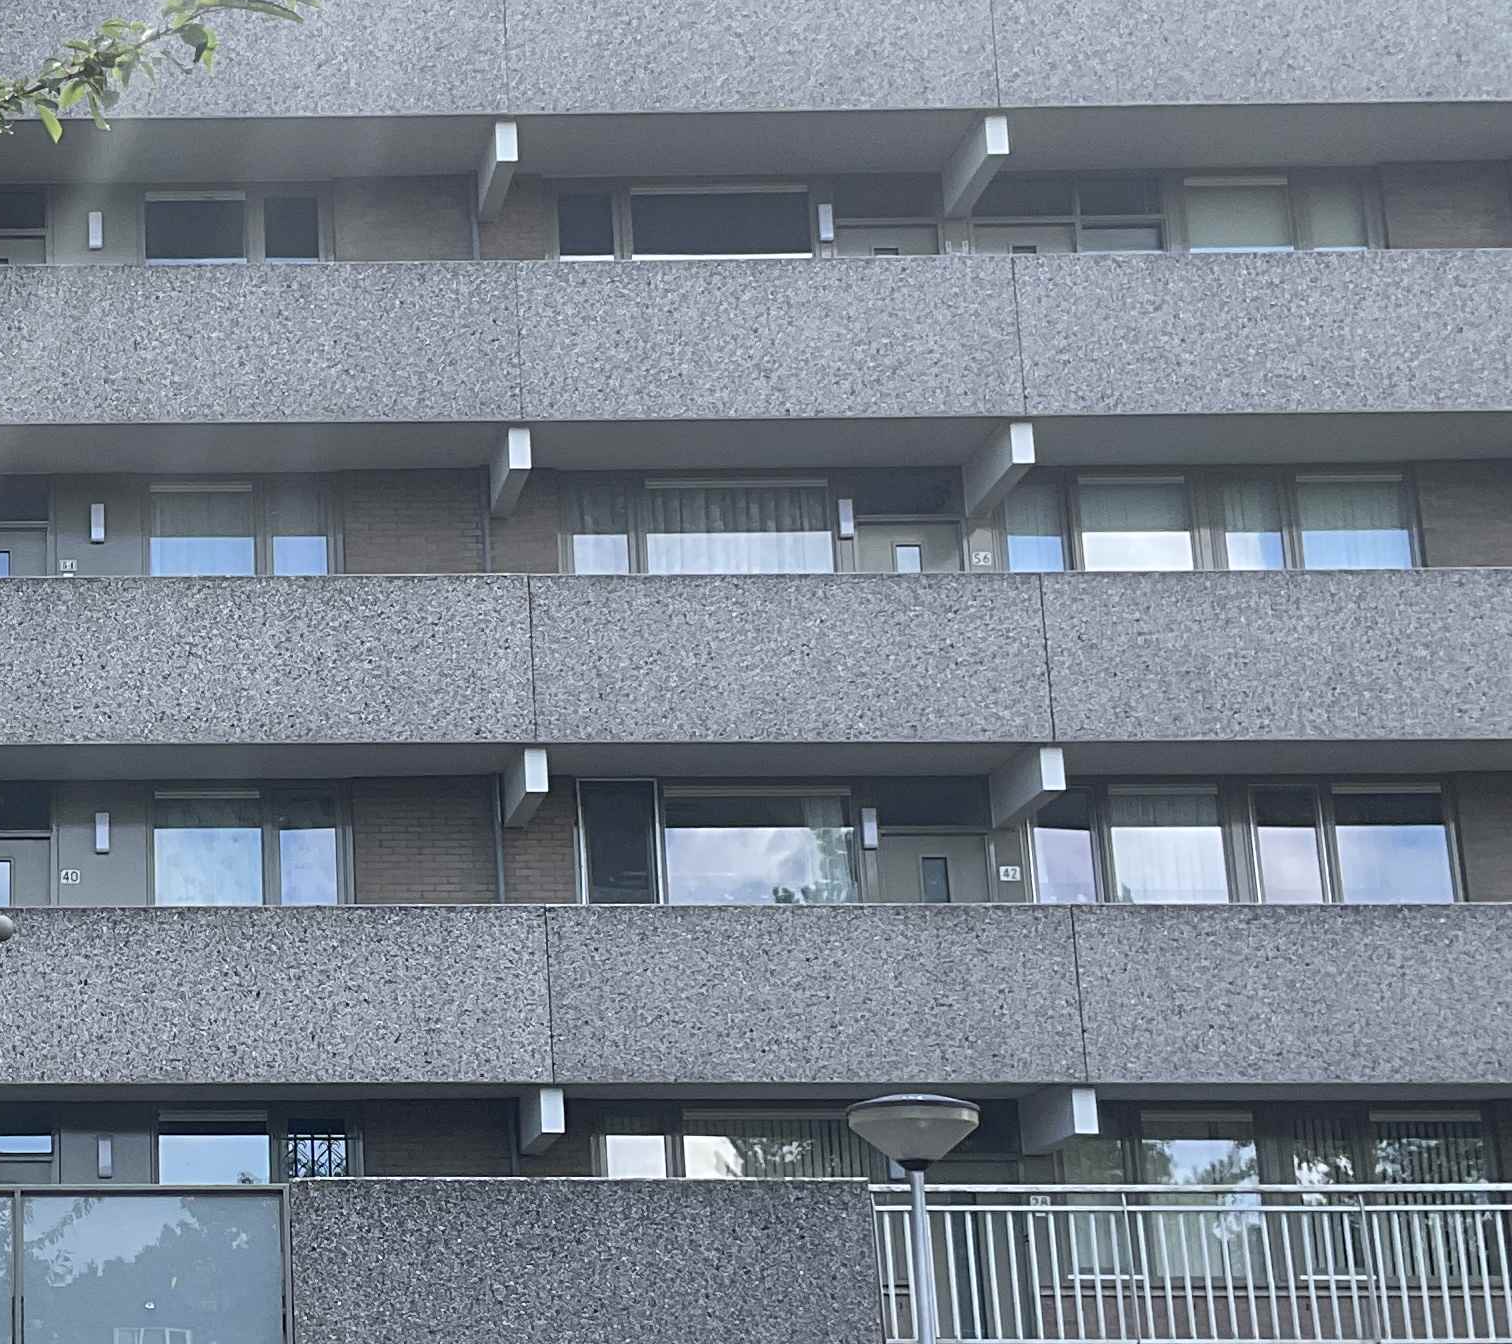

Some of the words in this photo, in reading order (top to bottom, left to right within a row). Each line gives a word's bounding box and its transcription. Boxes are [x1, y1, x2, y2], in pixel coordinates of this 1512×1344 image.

[974, 552, 990, 564] 56
[63, 870, 79, 882] 40
[1003, 867, 1018, 880] 42
